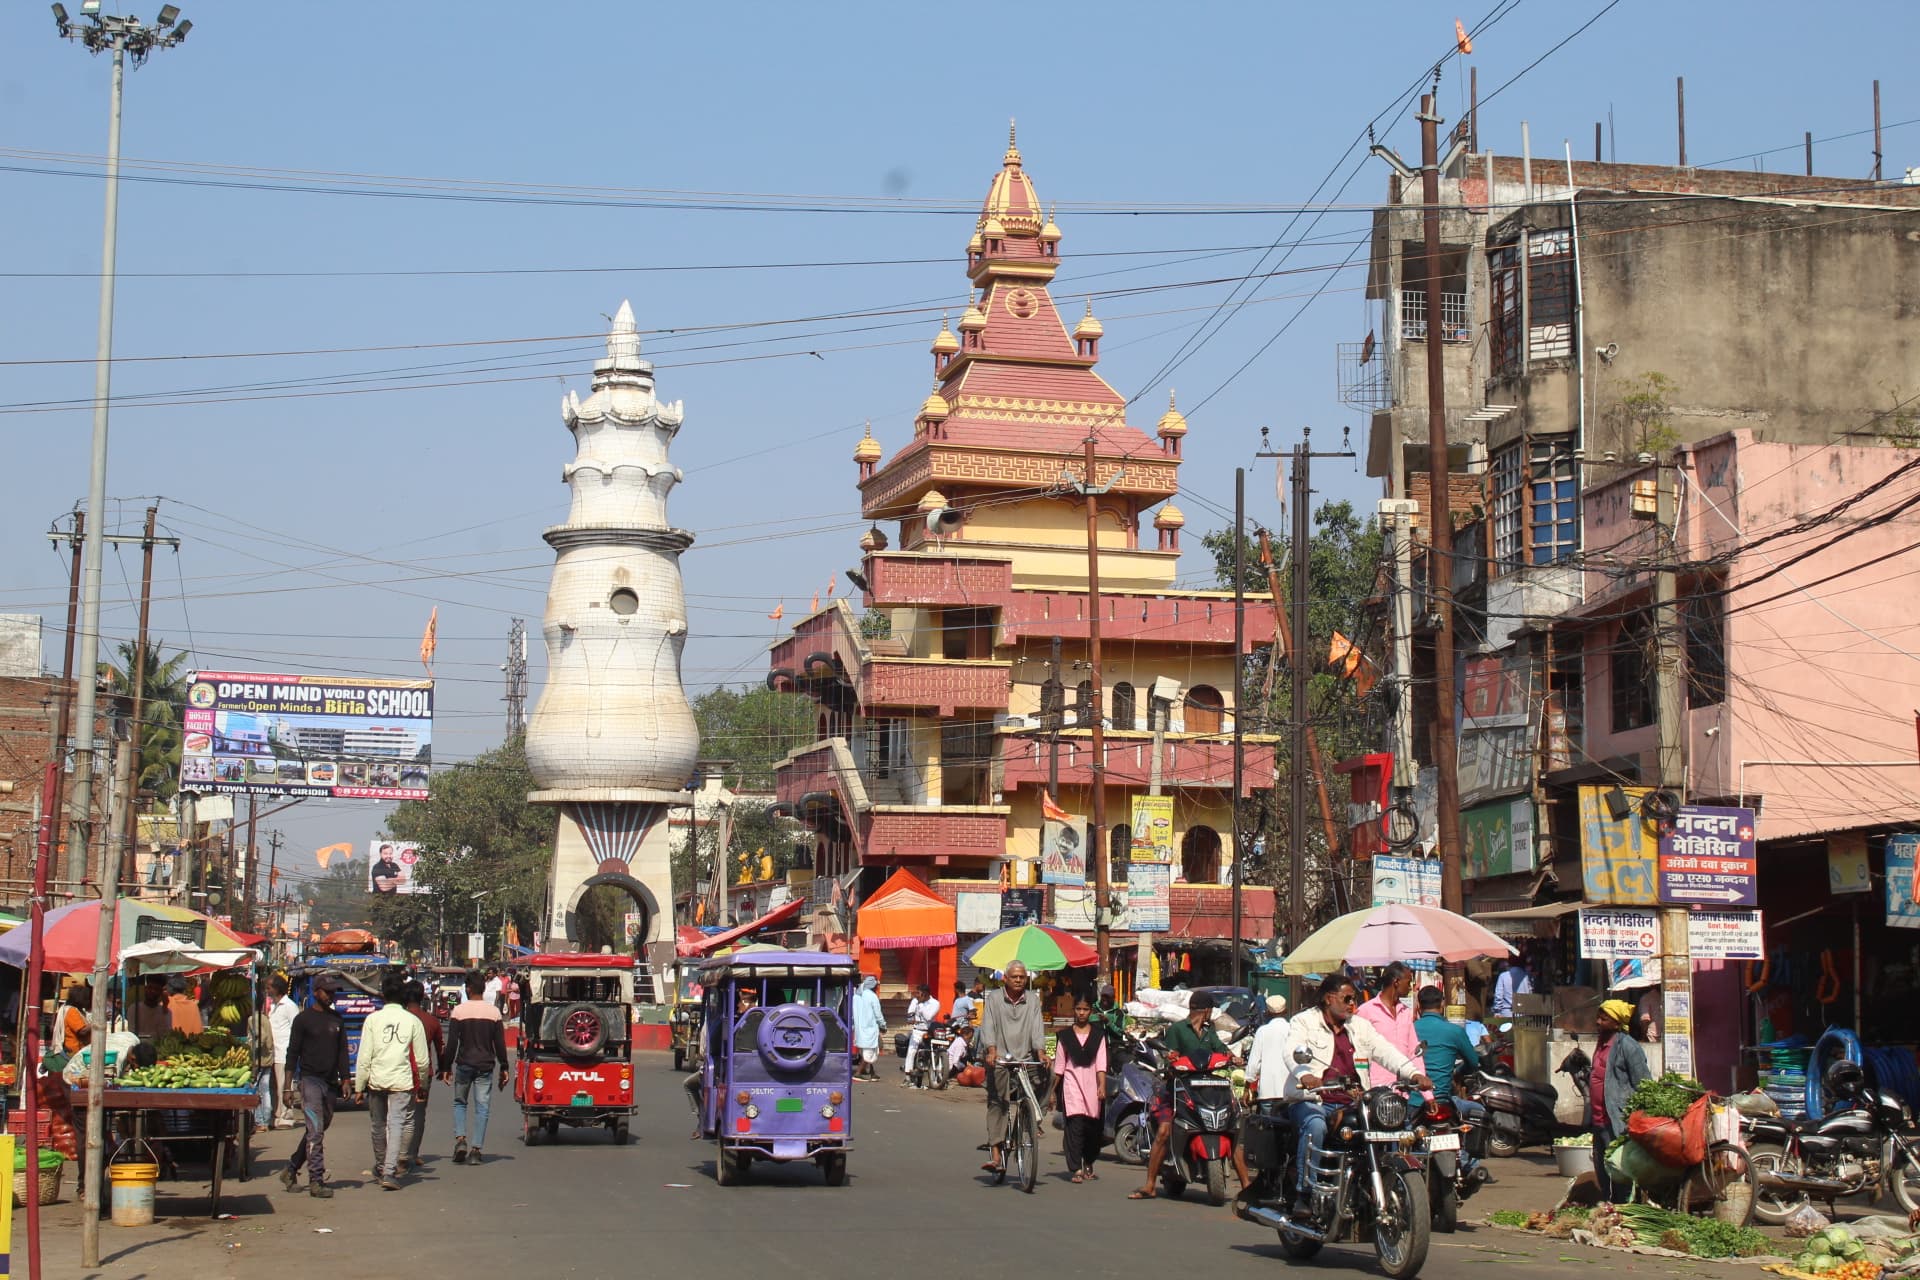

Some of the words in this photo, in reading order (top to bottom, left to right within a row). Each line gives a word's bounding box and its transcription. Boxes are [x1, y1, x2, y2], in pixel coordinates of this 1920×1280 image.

[218, 683, 268, 699] OPEN
[273, 685, 322, 701] MIND
[323, 688, 365, 700] WORLD
[366, 689, 432, 717] SCHOOL
[218, 702, 247, 711] Formerly
[248, 701, 277, 712] Open
[280, 702, 313, 713] Minds
[324, 699, 366, 714] Birla
[188, 711, 211, 721] HOSTEL
[186, 721, 212, 731] FACILITY
[184, 784, 213, 792] NEAR
[216, 785, 247, 793] TOWN
[290, 788, 328, 796] GIRIDIH
[1676, 813, 1738, 835] नन्दन
[1672, 834, 1741, 857] मेडिसिन
[1666, 856, 1698, 870] अंग्रेजी
[1701, 859, 1718, 869] दवा
[1720, 861, 1749, 873] दुकान
[1715, 875, 1749, 885] नन्दन
[1583, 913, 1611, 927] नन्दन
[1614, 912, 1653, 928] मेडिसिन
[1689, 912, 1721, 922] CREATIVE
[1723, 912, 1759, 923] INSTITUTE
[1618, 939, 1639, 949] नन्दन
[383, 1023, 407, 1043] K
[558, 1071, 605, 1082] ATUL
